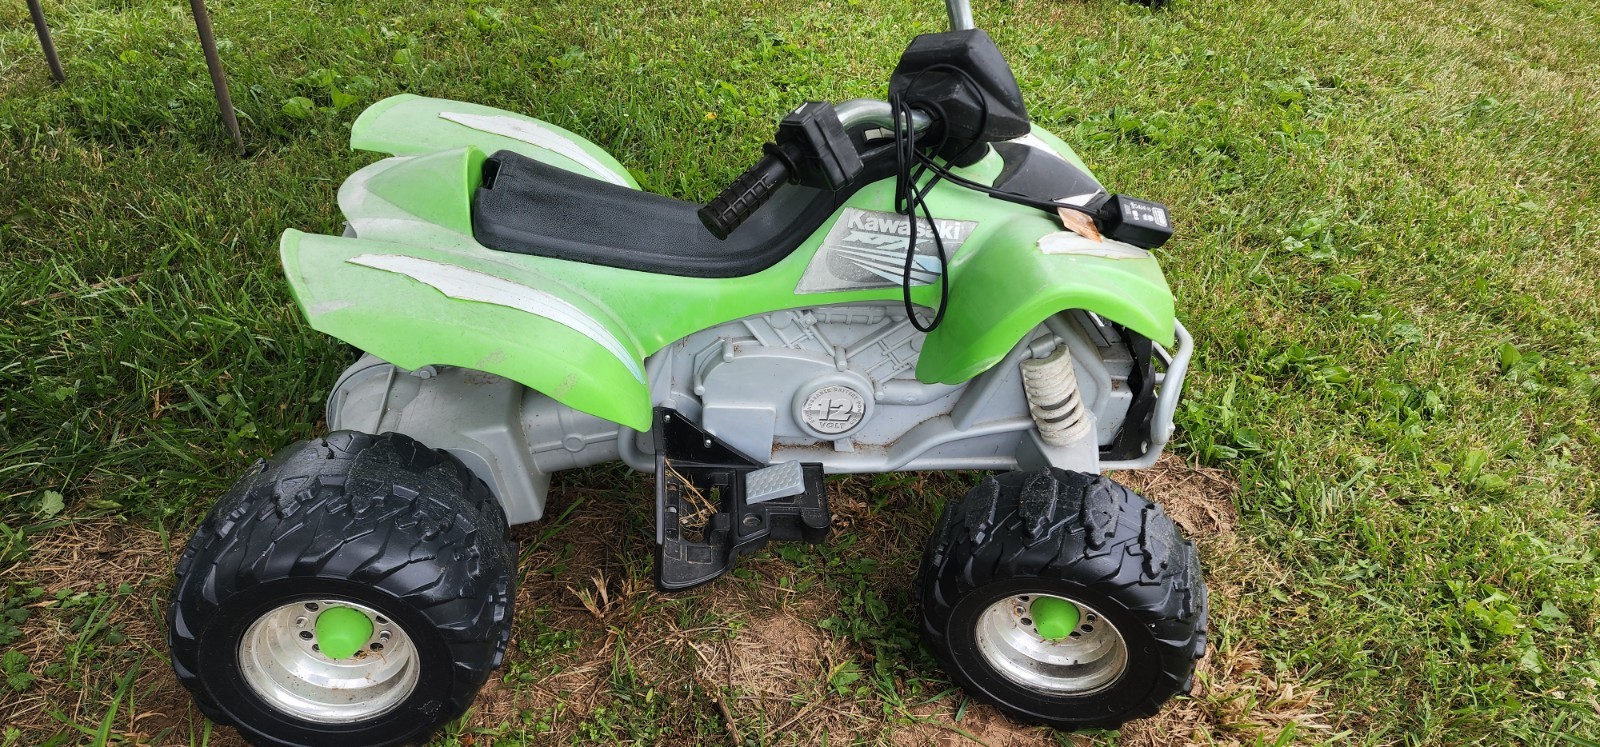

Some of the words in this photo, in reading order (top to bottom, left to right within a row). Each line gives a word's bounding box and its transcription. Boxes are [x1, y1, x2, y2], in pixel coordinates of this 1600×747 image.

[847, 210, 961, 240] Kawasaki
[817, 398, 853, 422] 12
[819, 421, 846, 429] VOLT
